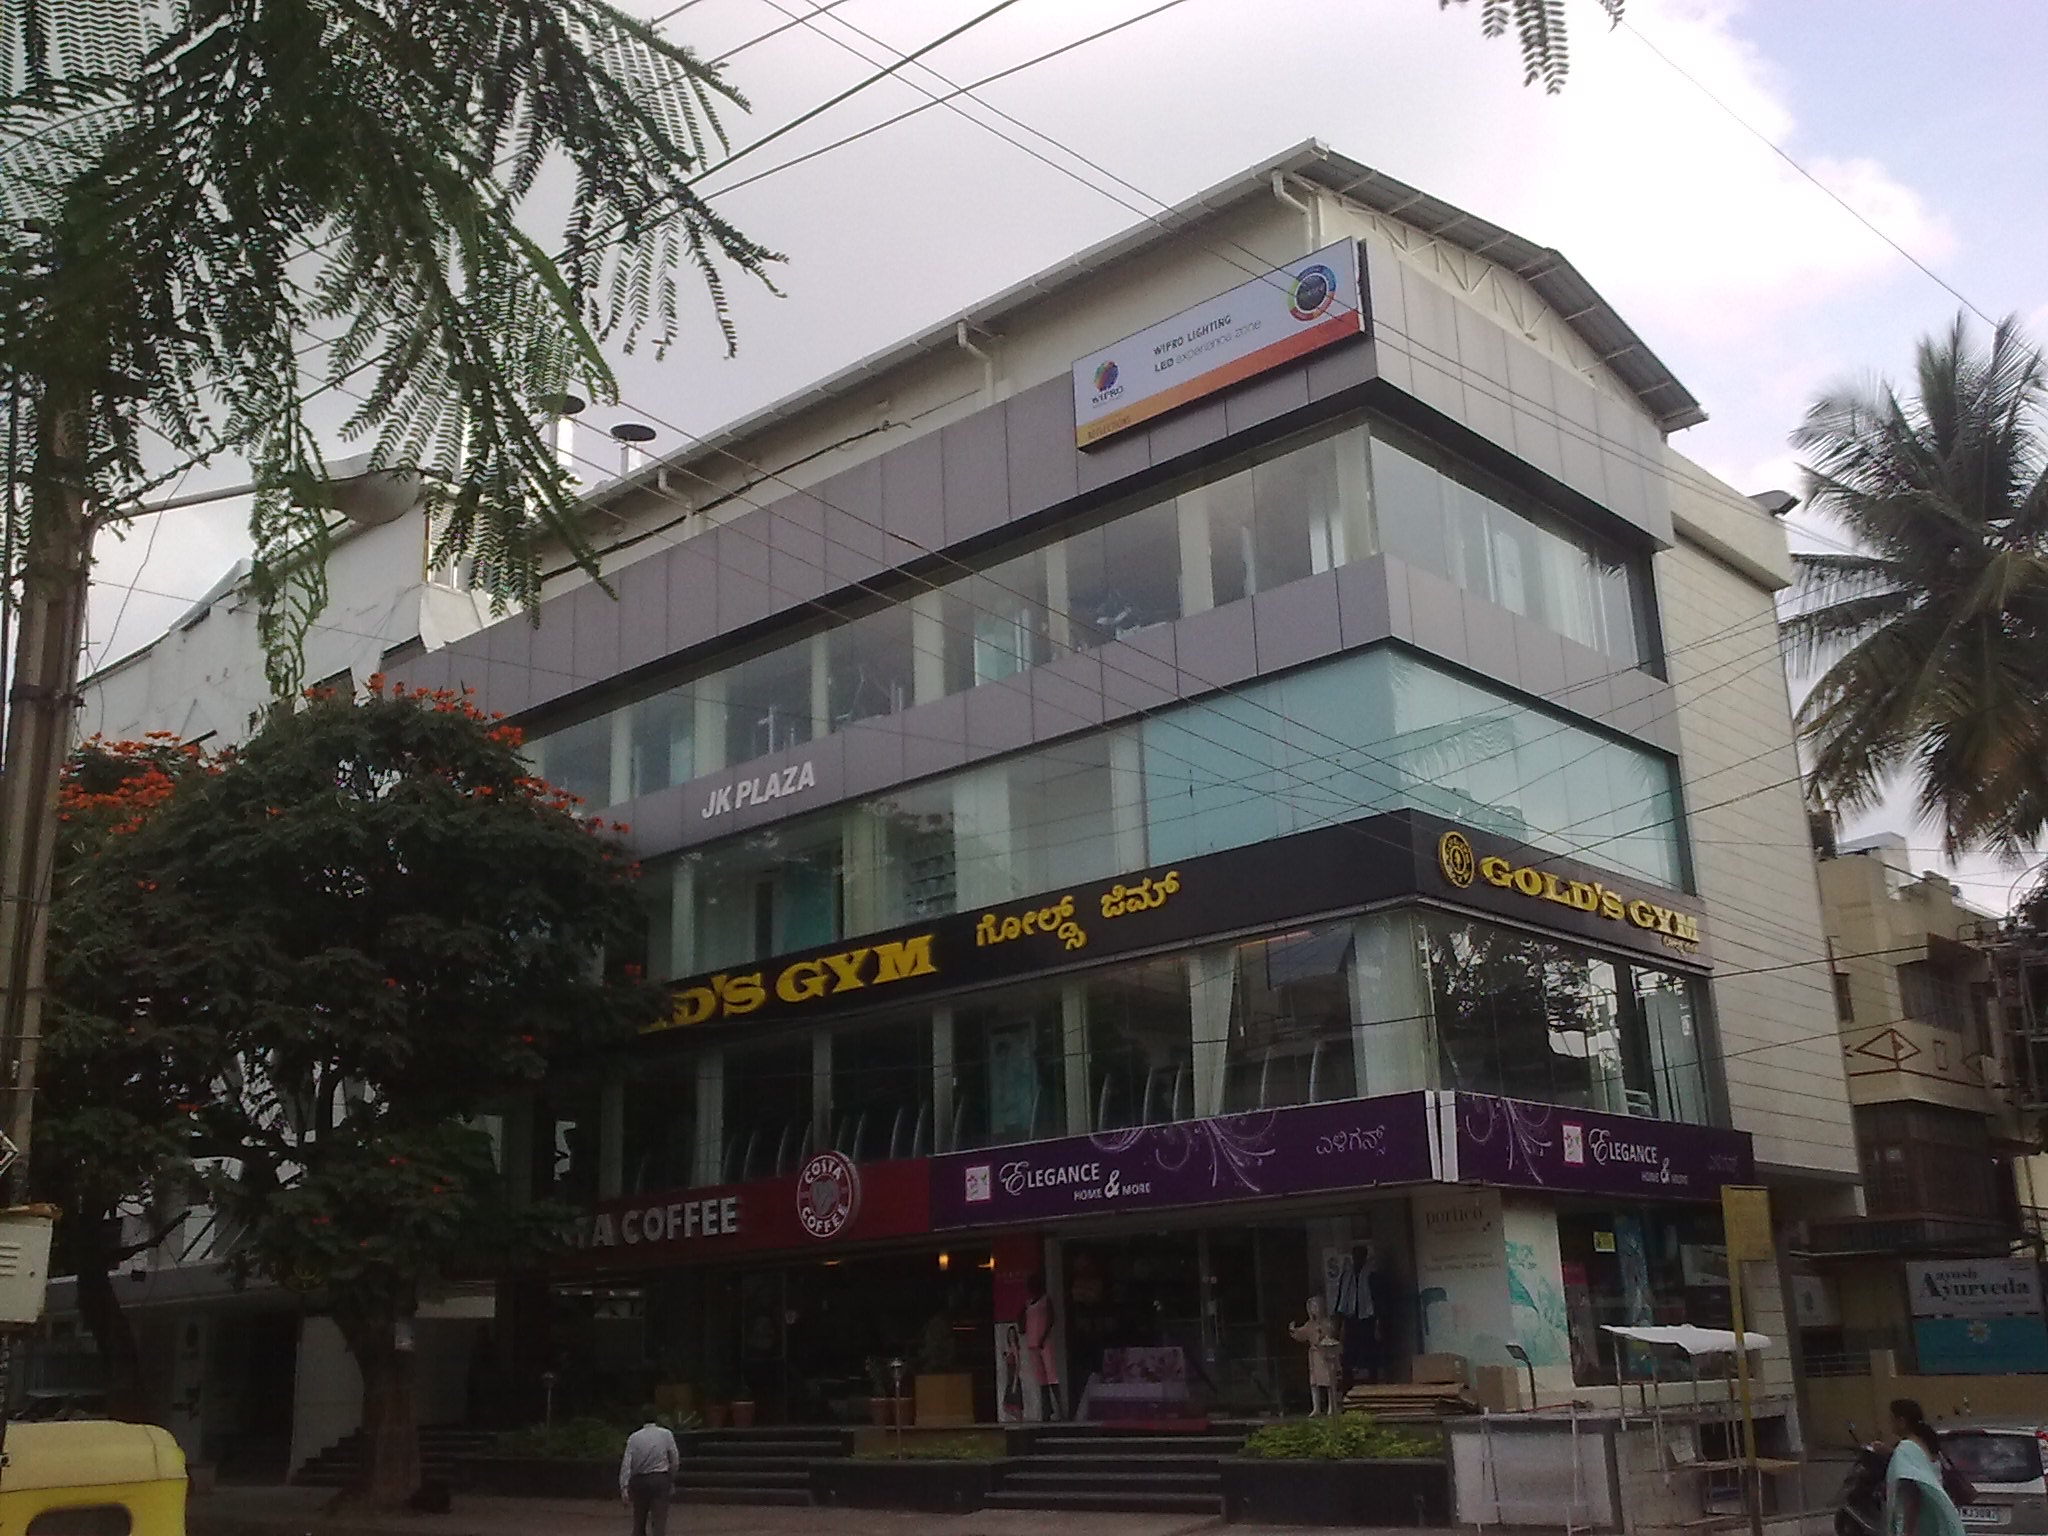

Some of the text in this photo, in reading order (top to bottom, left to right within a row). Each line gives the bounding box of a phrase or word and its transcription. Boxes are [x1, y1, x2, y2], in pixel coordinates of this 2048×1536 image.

[1153, 314, 1232, 356] WIPRO LIGHTING
[1154, 357, 1174, 373] LED
[702, 760, 816, 820] JK PLAZA
[1480, 855, 1626, 921] GOLD'S
[1626, 899, 1700, 944] GYM
[775, 933, 939, 1004] GYM
[1588, 1128, 1659, 1165] ELEGANCE
[805, 1158, 843, 1184] COSTA
[998, 1160, 1101, 1197] ELEGANCE
[1073, 1169, 1152, 1202] HOME & MORE
[621, 1196, 738, 1245] COFFEE
[802, 1203, 848, 1234] COFFEE
[1919, 1272, 2031, 1302] Ayurveda
